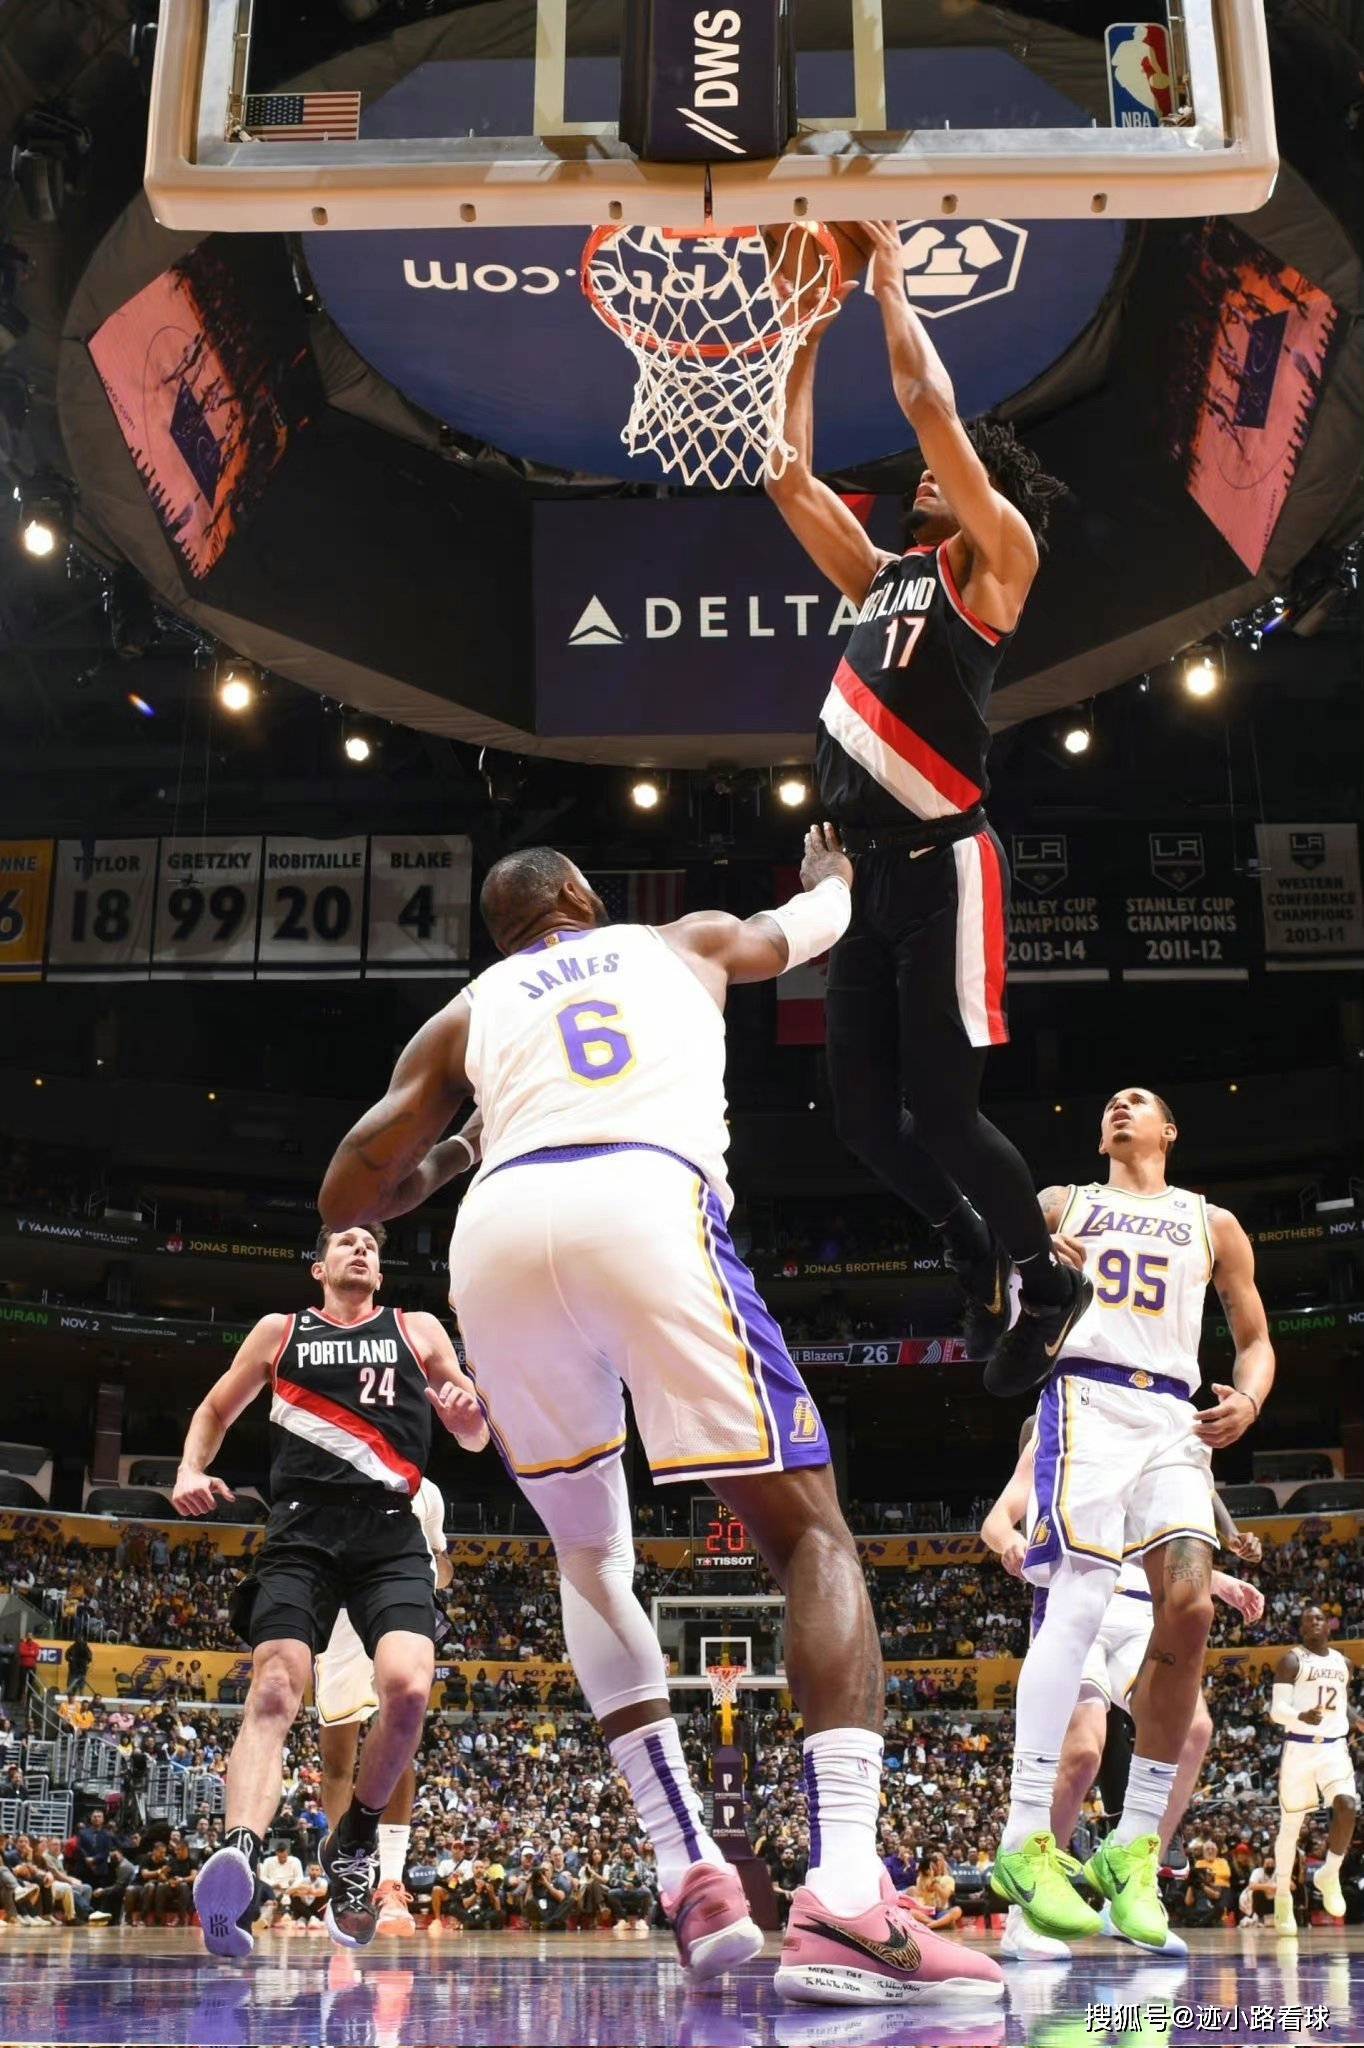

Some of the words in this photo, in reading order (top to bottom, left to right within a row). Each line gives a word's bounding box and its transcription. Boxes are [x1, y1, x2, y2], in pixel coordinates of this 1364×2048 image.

[1121, 111, 1153, 128] NBA
[645, 594, 859, 639] DELTA
[882, 616, 926, 669] 17
[72, 855, 141, 872] TYLOR
[167, 853, 252, 870] GRETZKY
[268, 852, 361, 869] ROBITAILLE
[391, 852, 452, 868] BLAKE
[1277, 878, 1343, 889] WESTERN
[168, 885, 247, 941] 99
[272, 885, 352, 940] 20
[397, 884, 437, 938] 4
[1064, 897, 1097, 912] CUP
[1126, 898, 1198, 913] STANLEY
[1202, 897, 1236, 912] CUP
[1274, 908, 1354, 921] CHAMPIONS
[71, 888, 131, 942] 18
[1127, 914, 1237, 932] CHAMPIONS
[1008, 940, 1088, 962] 2013-14
[1145, 939, 1224, 960] 2011-12
[519, 953, 621, 1000] JAMES
[555, 998, 635, 1085] 6
[1075, 1204, 1192, 1246] LAKERS
[1258, 1227, 1324, 1242] BROTHERS
[188, 1240, 228, 1254] JONAS
[232, 1244, 295, 1260] BROTHERS
[803, 1263, 842, 1275] JONAS
[846, 1261, 908, 1273] BROTHERS
[914, 1258, 941, 1270] NOV.
[1096, 1249, 1168, 1314] 95
[61, 1317, 89, 1330] NOV.
[92, 1320, 100, 1331] 2
[296, 1339, 398, 1368] PORTLAND
[802, 1350, 845, 1362] Blazers
[862, 1346, 889, 1364] 26
[359, 1367, 396, 1406] 24
[706, 1522, 744, 1551] 20
[1318, 1686, 1337, 1711] 12
